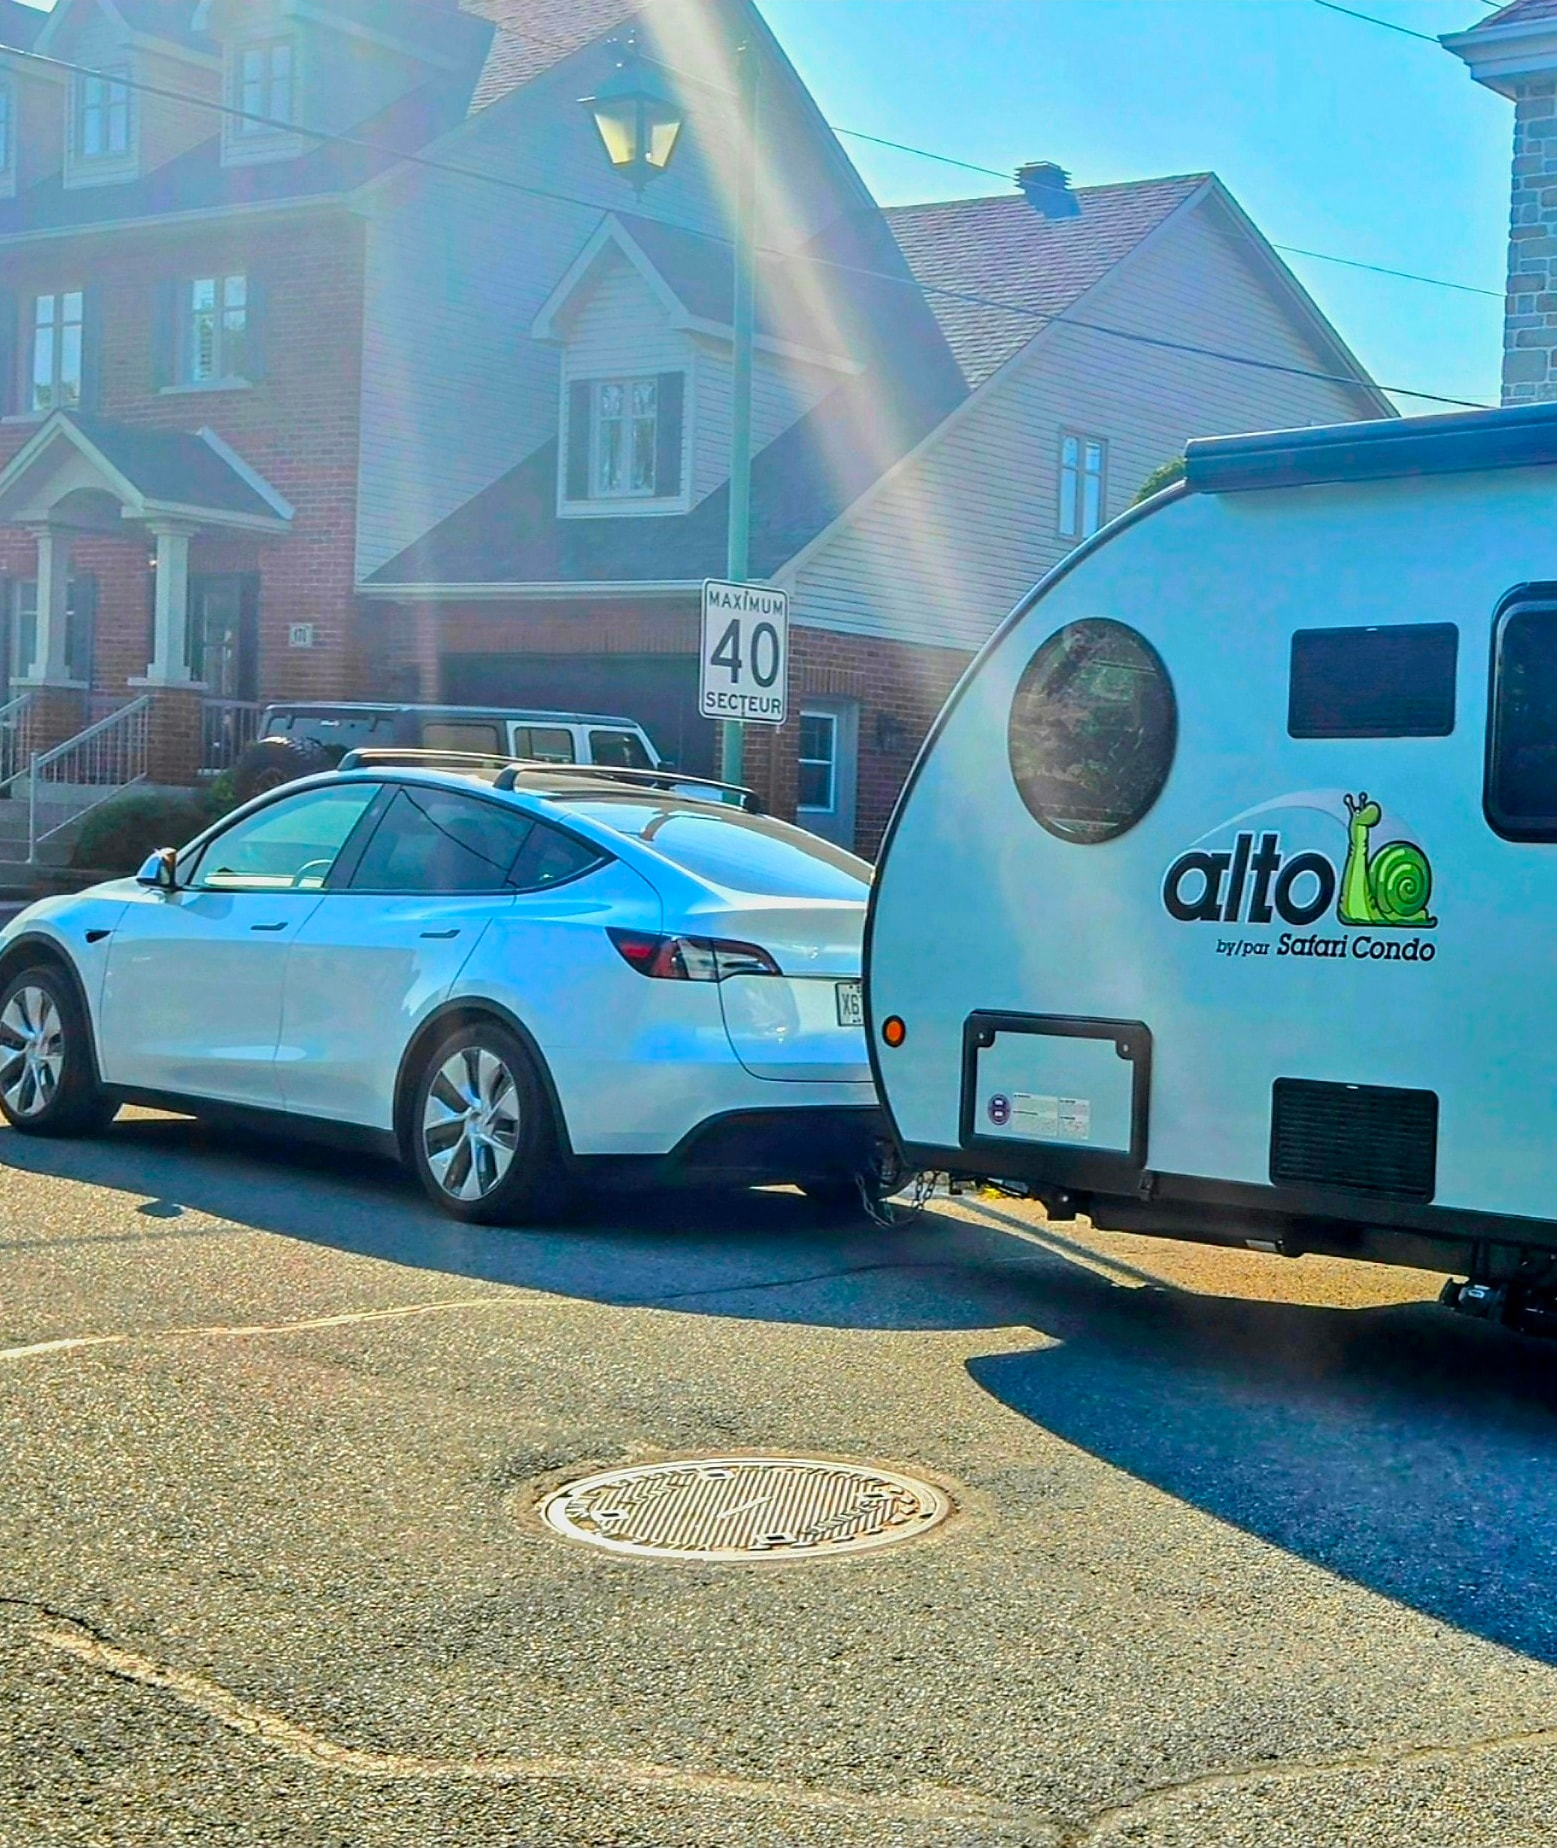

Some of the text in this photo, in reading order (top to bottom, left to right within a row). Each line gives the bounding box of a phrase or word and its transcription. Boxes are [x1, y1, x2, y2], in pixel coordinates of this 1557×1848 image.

[708, 590, 783, 615] MAXIMUM
[710, 618, 780, 688] 40
[705, 691, 781, 714] SECTEUR
[1162, 832, 1336, 926] alto
[1276, 933, 1348, 958] Safari
[1352, 936, 1436, 961] Condo
[842, 993, 863, 1015] X6
